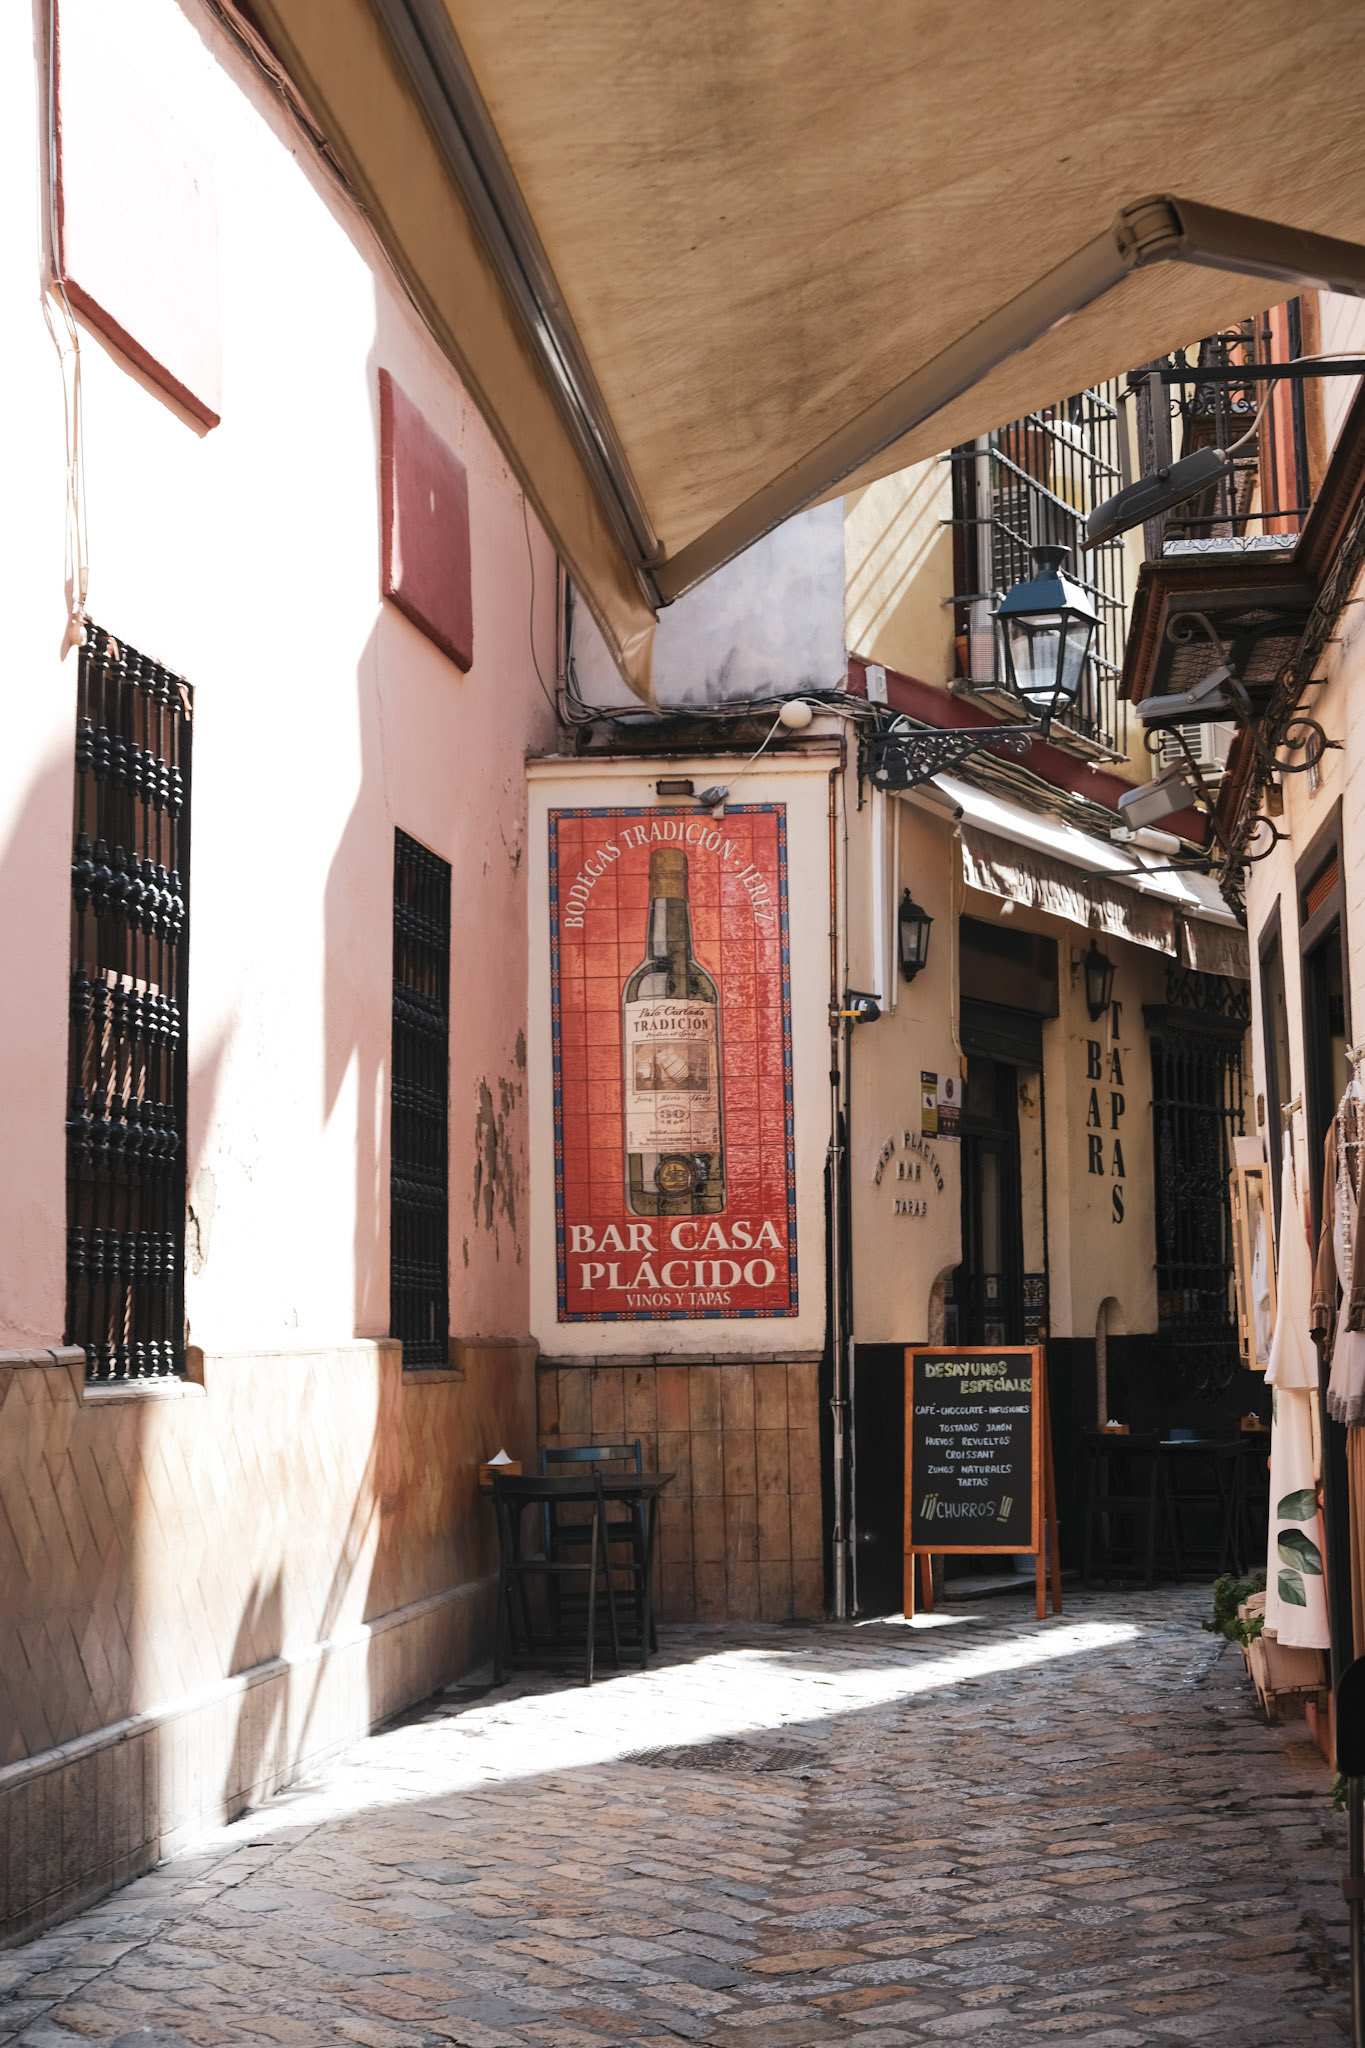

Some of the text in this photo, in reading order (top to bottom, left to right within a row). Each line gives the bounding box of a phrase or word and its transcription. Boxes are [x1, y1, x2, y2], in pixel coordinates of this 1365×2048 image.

[564, 820, 774, 928] BODEGAS TRADICIÓN JEREZ
[1086, 1040, 1104, 1176] BAR
[1109, 1000, 1126, 1224] TAPAS
[876, 1139, 895, 1186] CASA
[899, 1162, 921, 1180] BAR
[895, 1199, 927, 1215] TAPAS
[569, 1220, 785, 1253] BAR CASA
[579, 1253, 776, 1291] PLÁCIDO
[626, 1291, 731, 1307] VINOS Y TAPAS
[925, 1360, 1008, 1378] DESAYUNOS
[939, 1423, 980, 1433] TOSTADAS
[925, 1436, 1011, 1446] HUEVOS REVUELTOS
[945, 1449, 995, 1459] CROISSANT
[928, 1464, 1012, 1474] ZUMOS NATURALES
[956, 1478, 989, 1487] TARTAS
